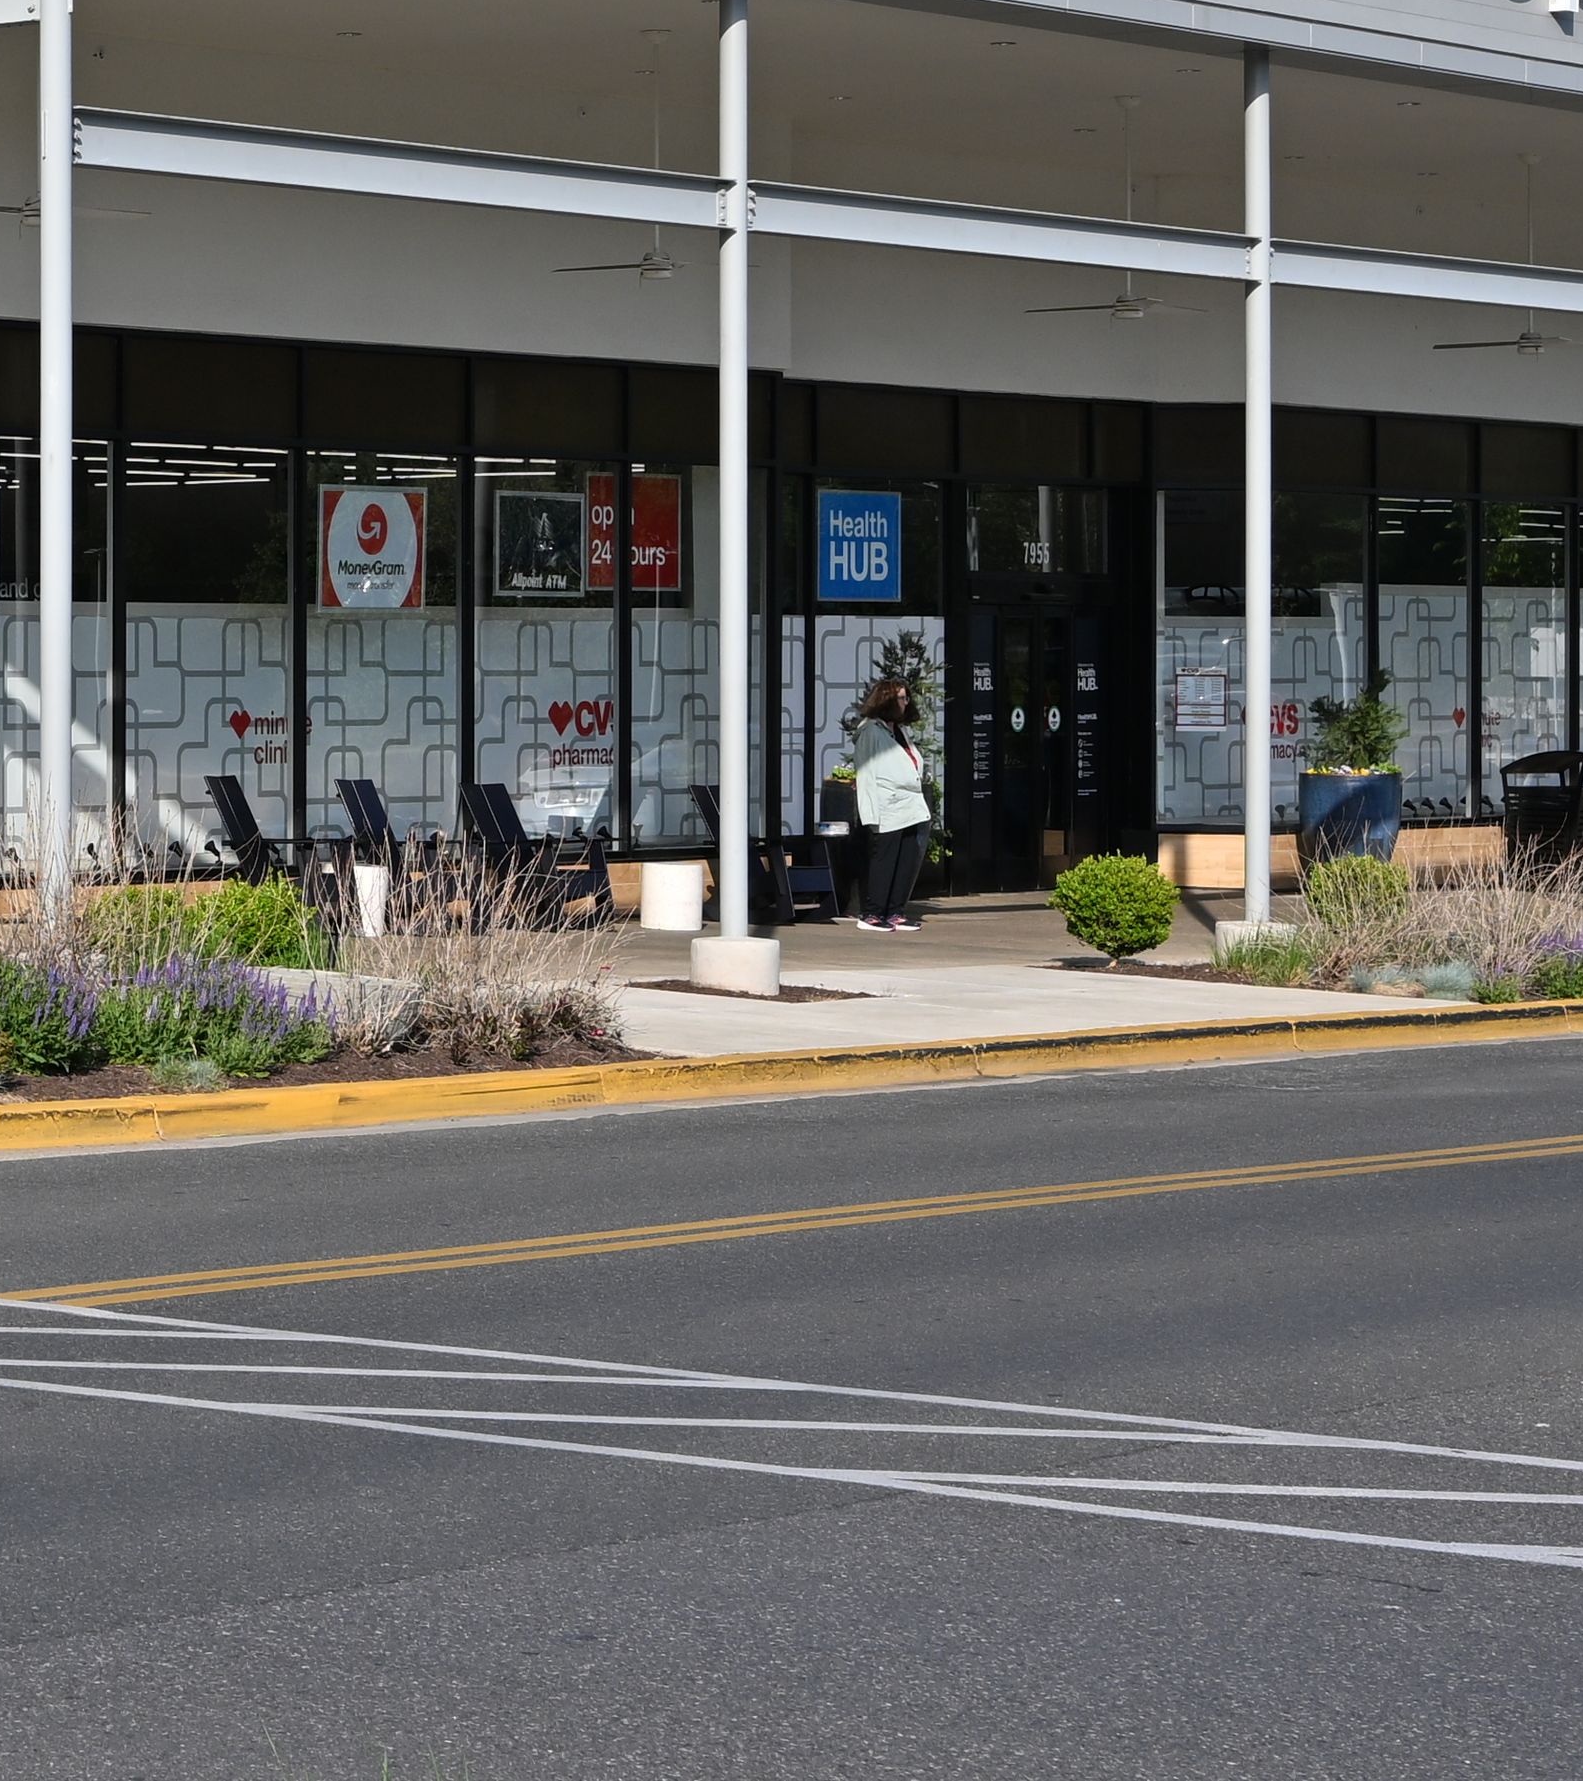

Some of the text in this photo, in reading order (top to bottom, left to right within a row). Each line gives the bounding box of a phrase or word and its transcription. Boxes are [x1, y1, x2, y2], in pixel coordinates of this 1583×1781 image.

[829, 509, 888, 539] Health
[591, 539, 613, 565] 24
[829, 541, 889, 582] HUB
[1022, 542, 1051, 565] 7955
[0, 576, 28, 599] and
[545, 574, 567, 590] ATM
[574, 700, 614, 737] CV
